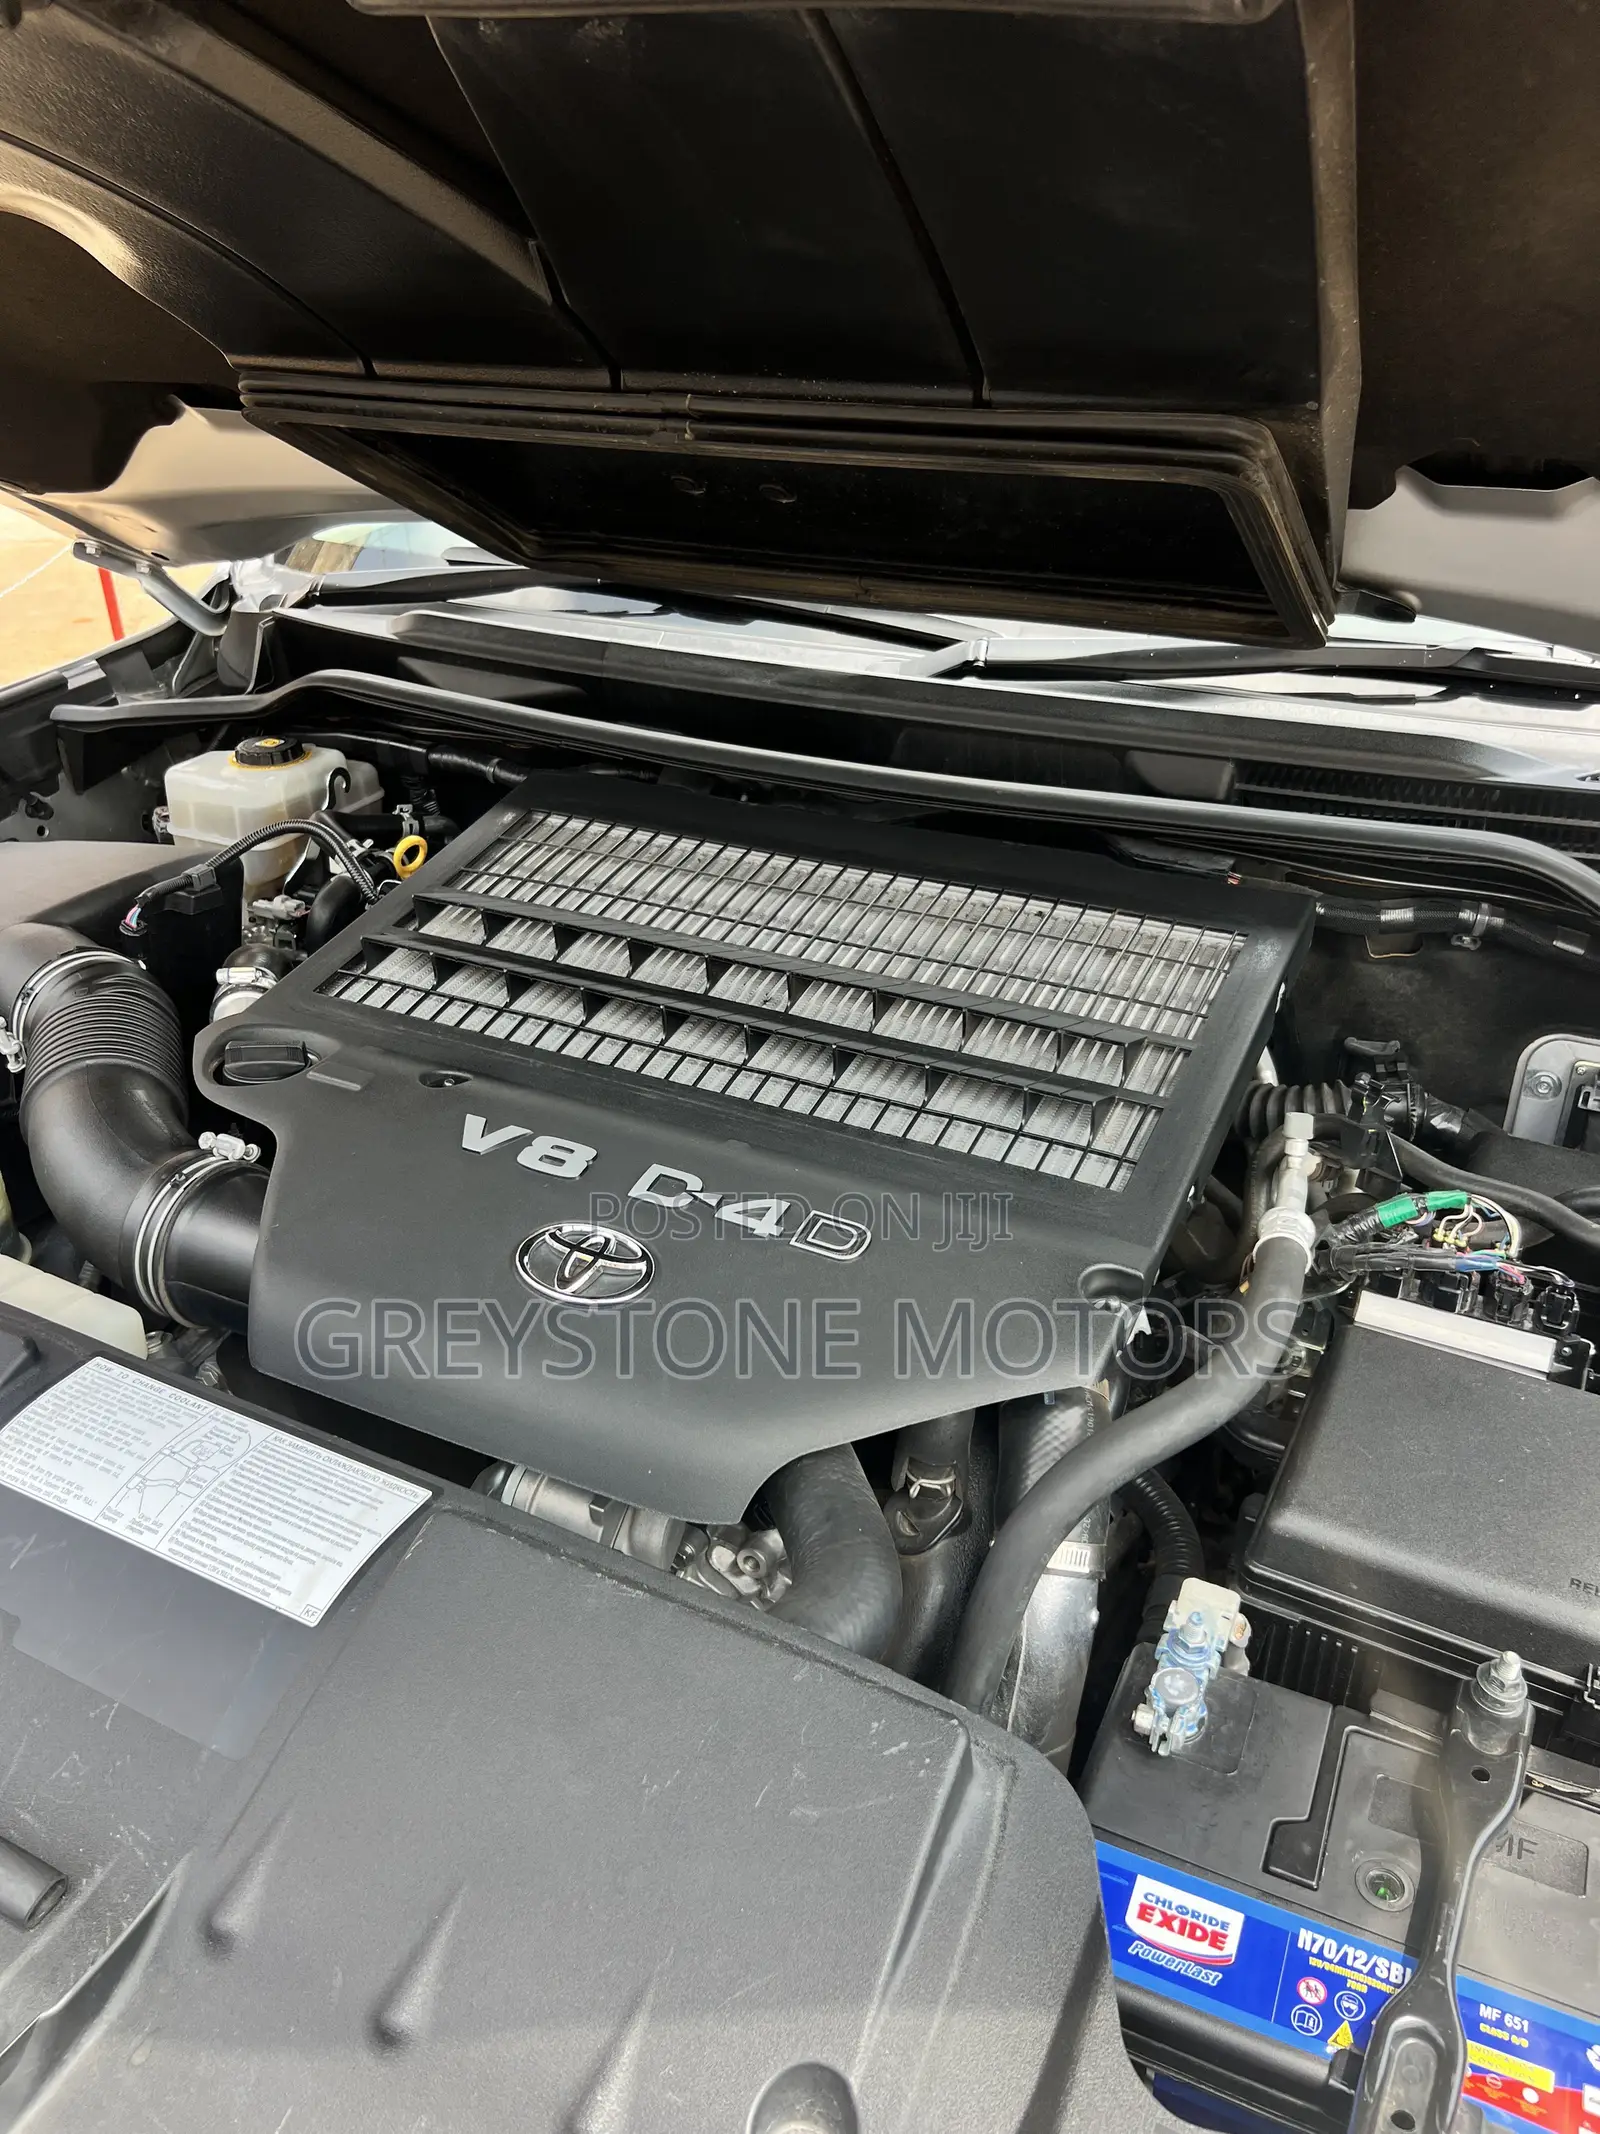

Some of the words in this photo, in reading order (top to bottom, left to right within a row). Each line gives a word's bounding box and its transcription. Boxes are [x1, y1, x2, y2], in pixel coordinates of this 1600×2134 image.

[461, 1113, 599, 1179] V8
[627, 1163, 873, 1263] D-4D
[94, 1362, 113, 1374] HOW
[116, 1371, 129, 1379] TO
[132, 1378, 166, 1394] CHANGE
[168, 1393, 209, 1412] COOLANT
[304, 1608, 317, 1618] KF
[1136, 1902, 1229, 1952] EXIDE
[1143, 1891, 1231, 1931] CHLORIDE
[1479, 2003, 1502, 2021] MF
[1504, 2013, 1529, 2033] 651
